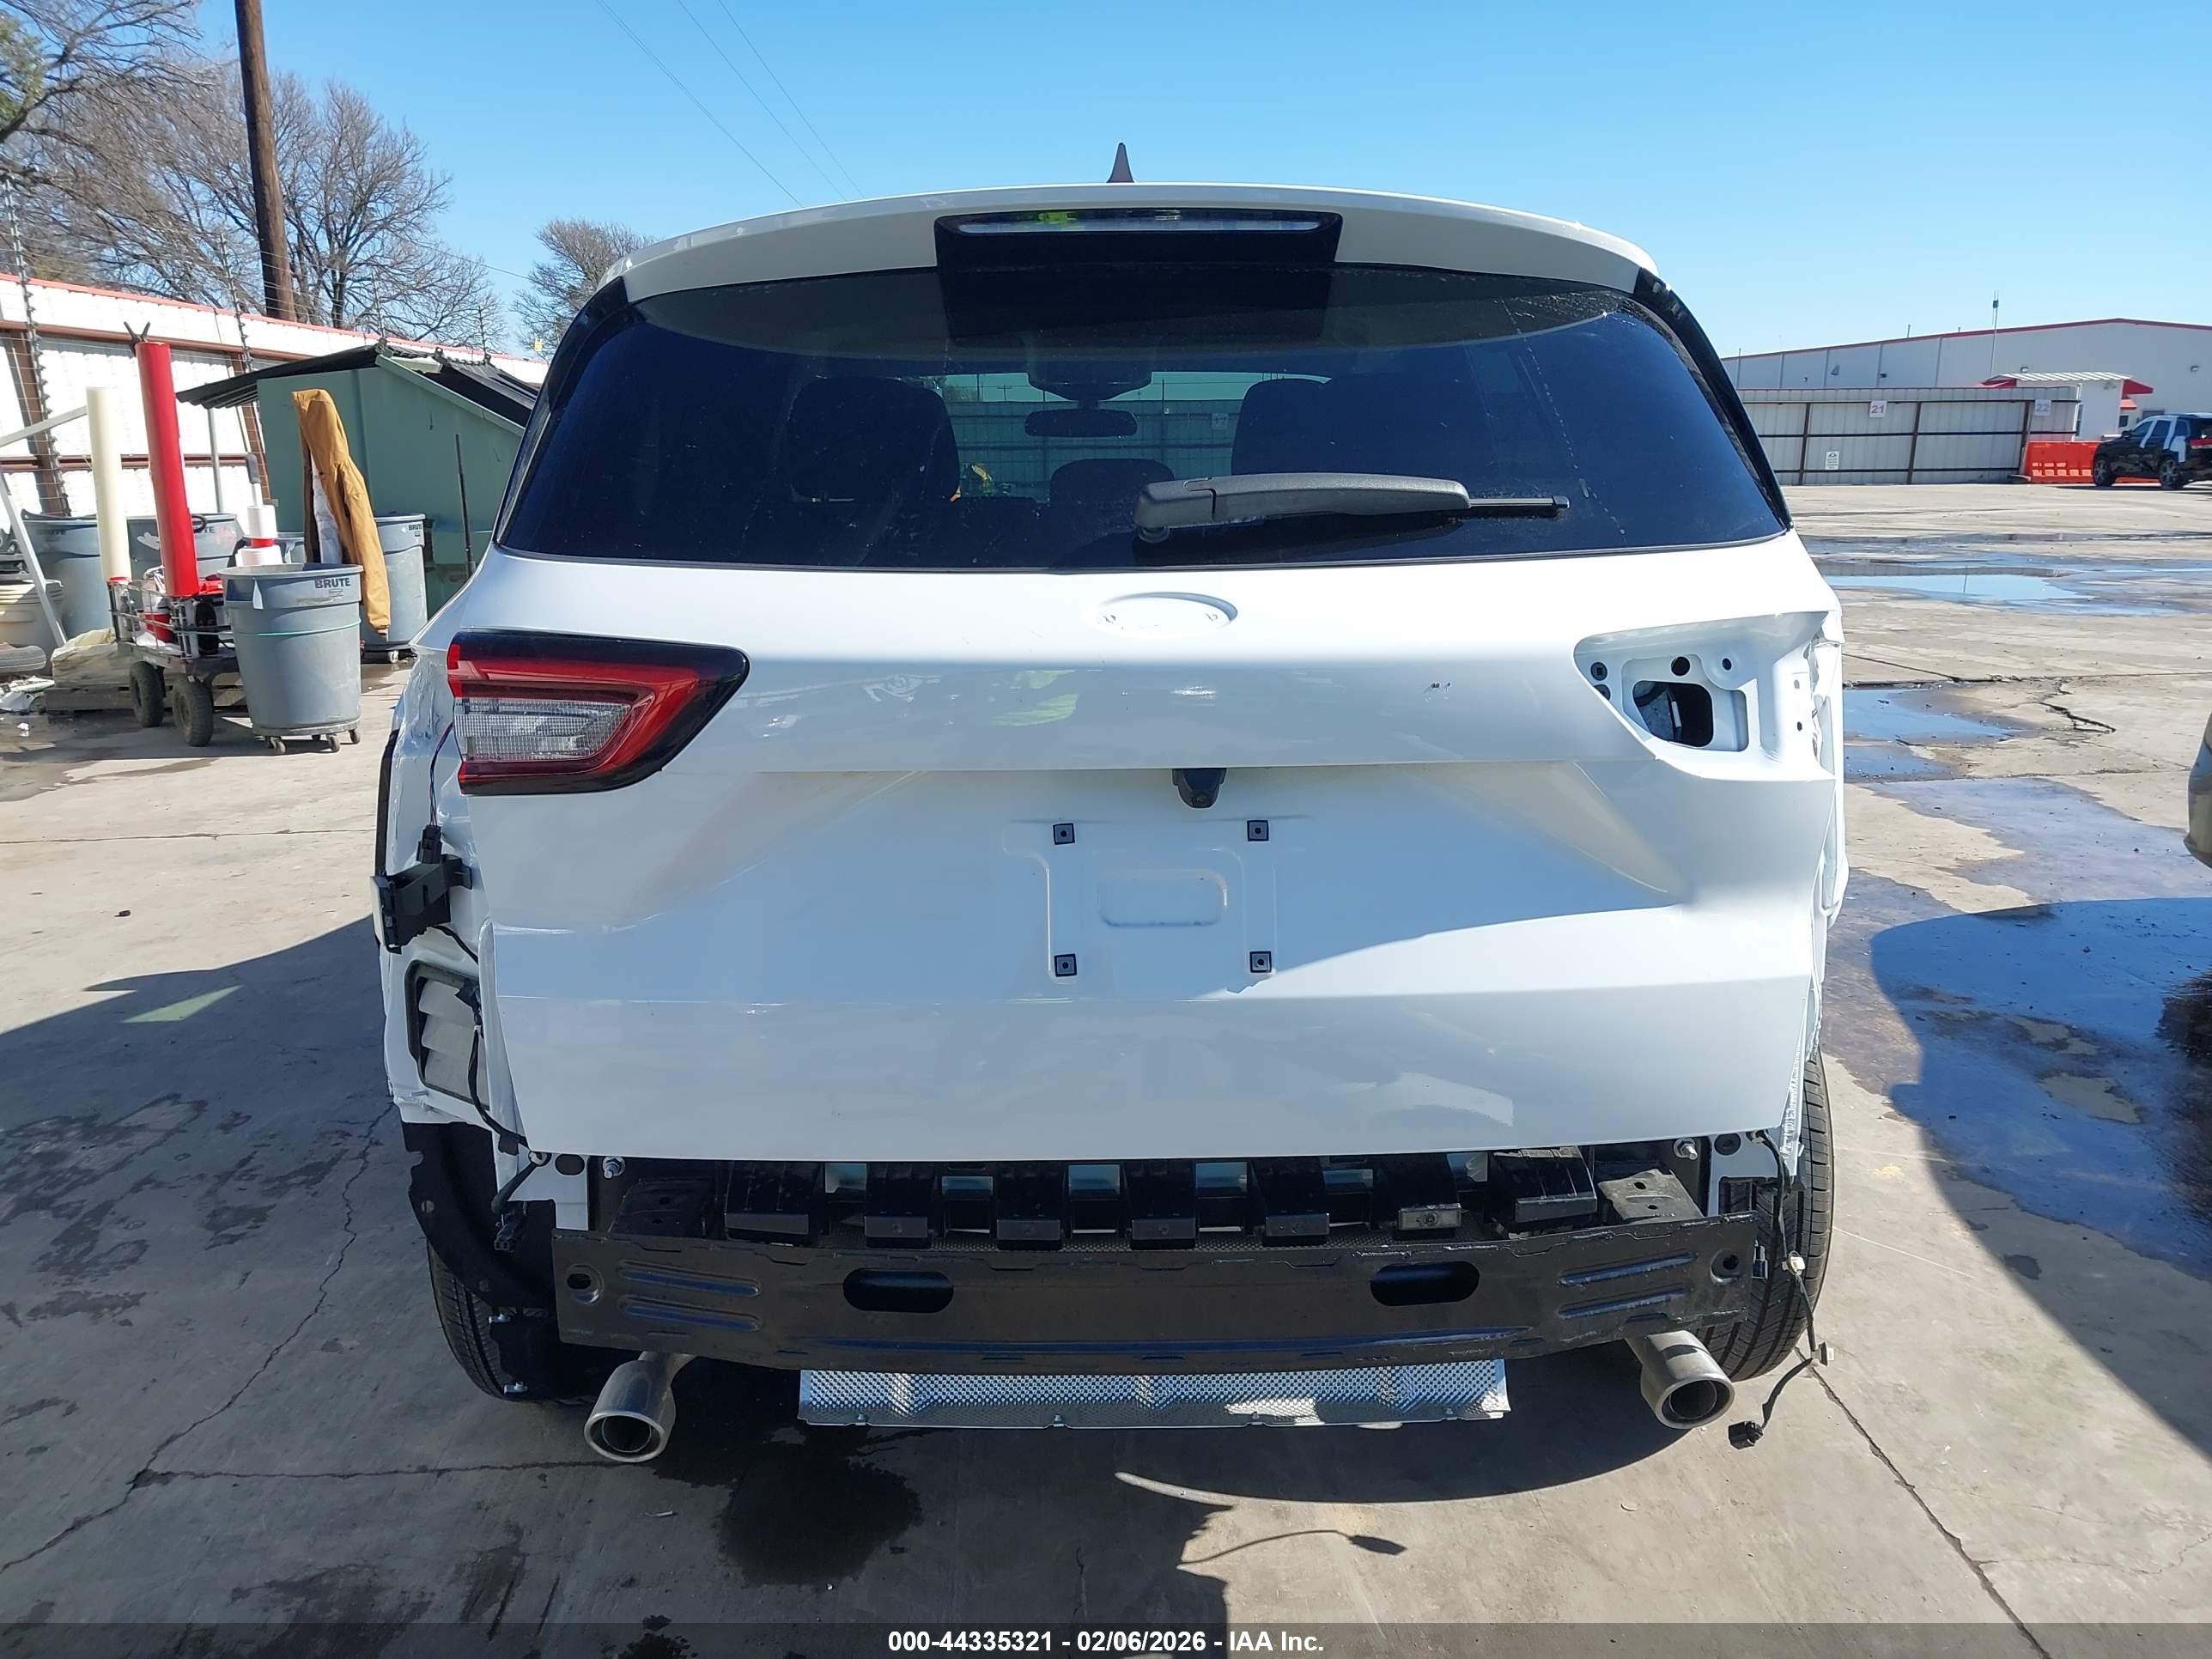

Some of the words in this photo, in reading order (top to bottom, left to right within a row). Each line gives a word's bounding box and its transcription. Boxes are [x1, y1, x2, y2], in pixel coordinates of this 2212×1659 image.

[1871, 404, 1884, 414] 21
[2036, 404, 2049, 412] 22
[314, 578, 351, 589] BRUTE
